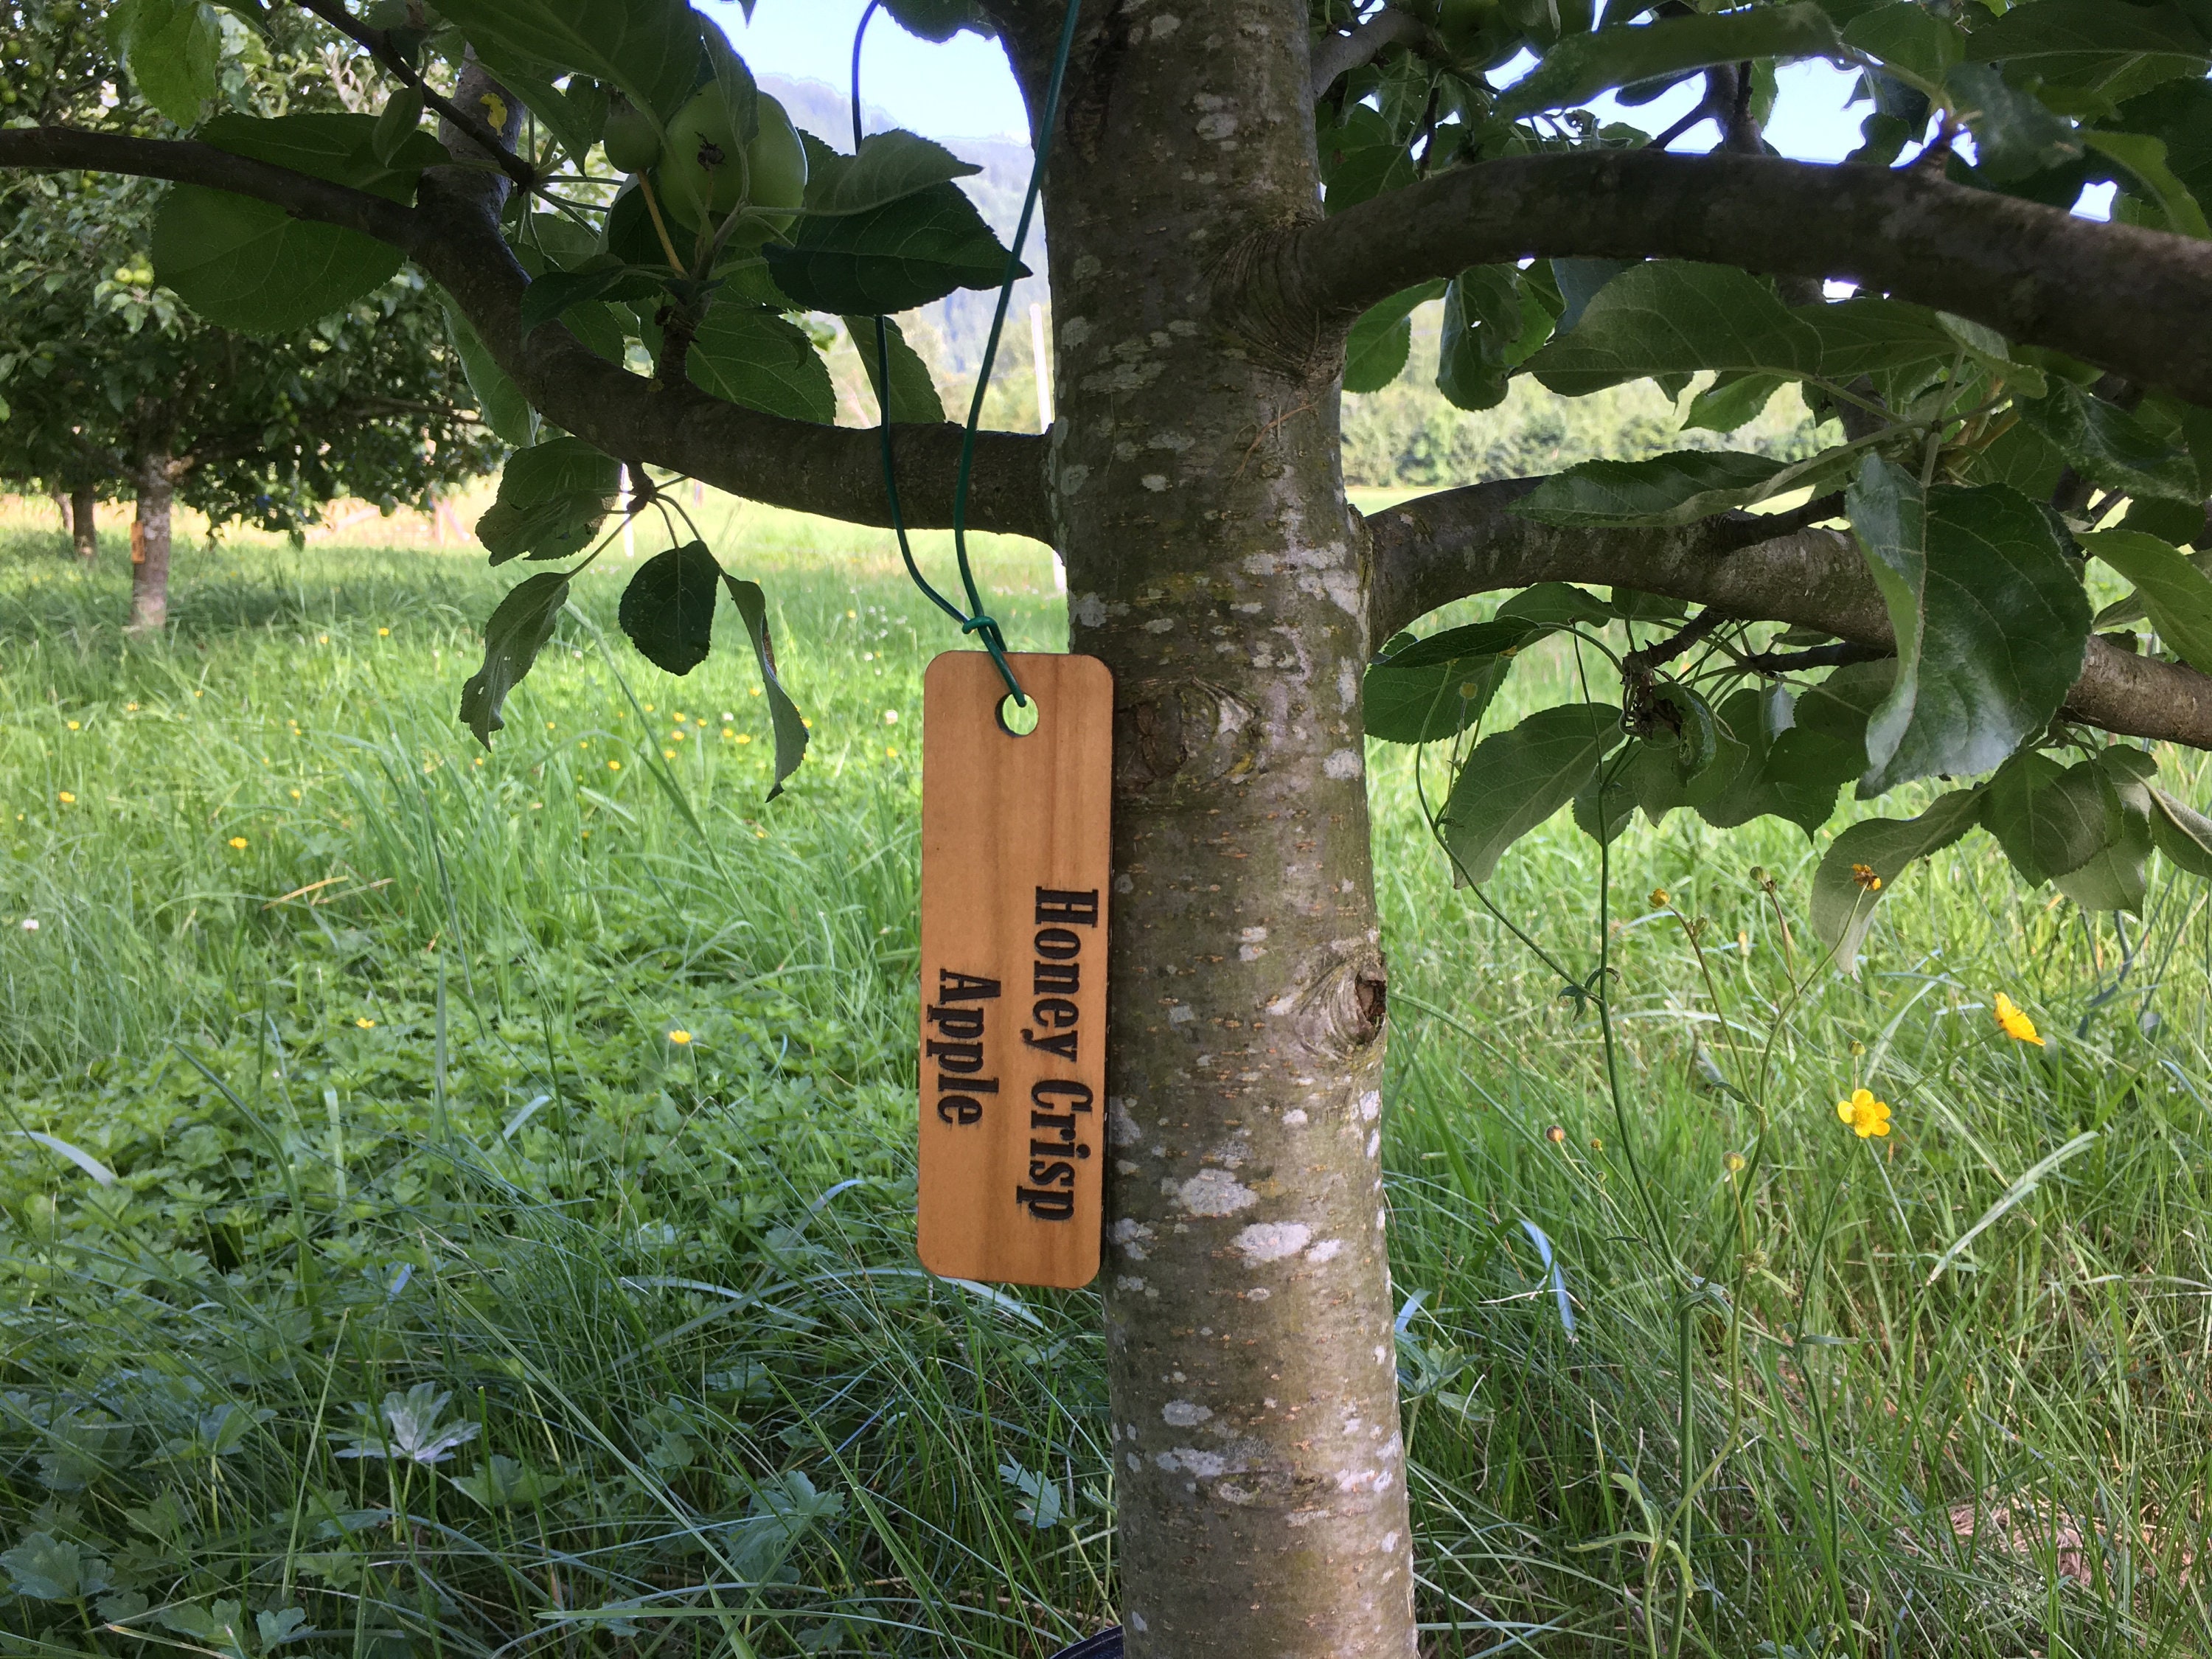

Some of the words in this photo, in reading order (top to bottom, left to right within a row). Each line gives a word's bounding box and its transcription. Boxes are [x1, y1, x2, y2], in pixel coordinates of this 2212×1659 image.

[927, 968, 1001, 1125] Apple
[1020, 886, 1099, 1062] Honey
[1016, 1079, 1093, 1222] Crisp
